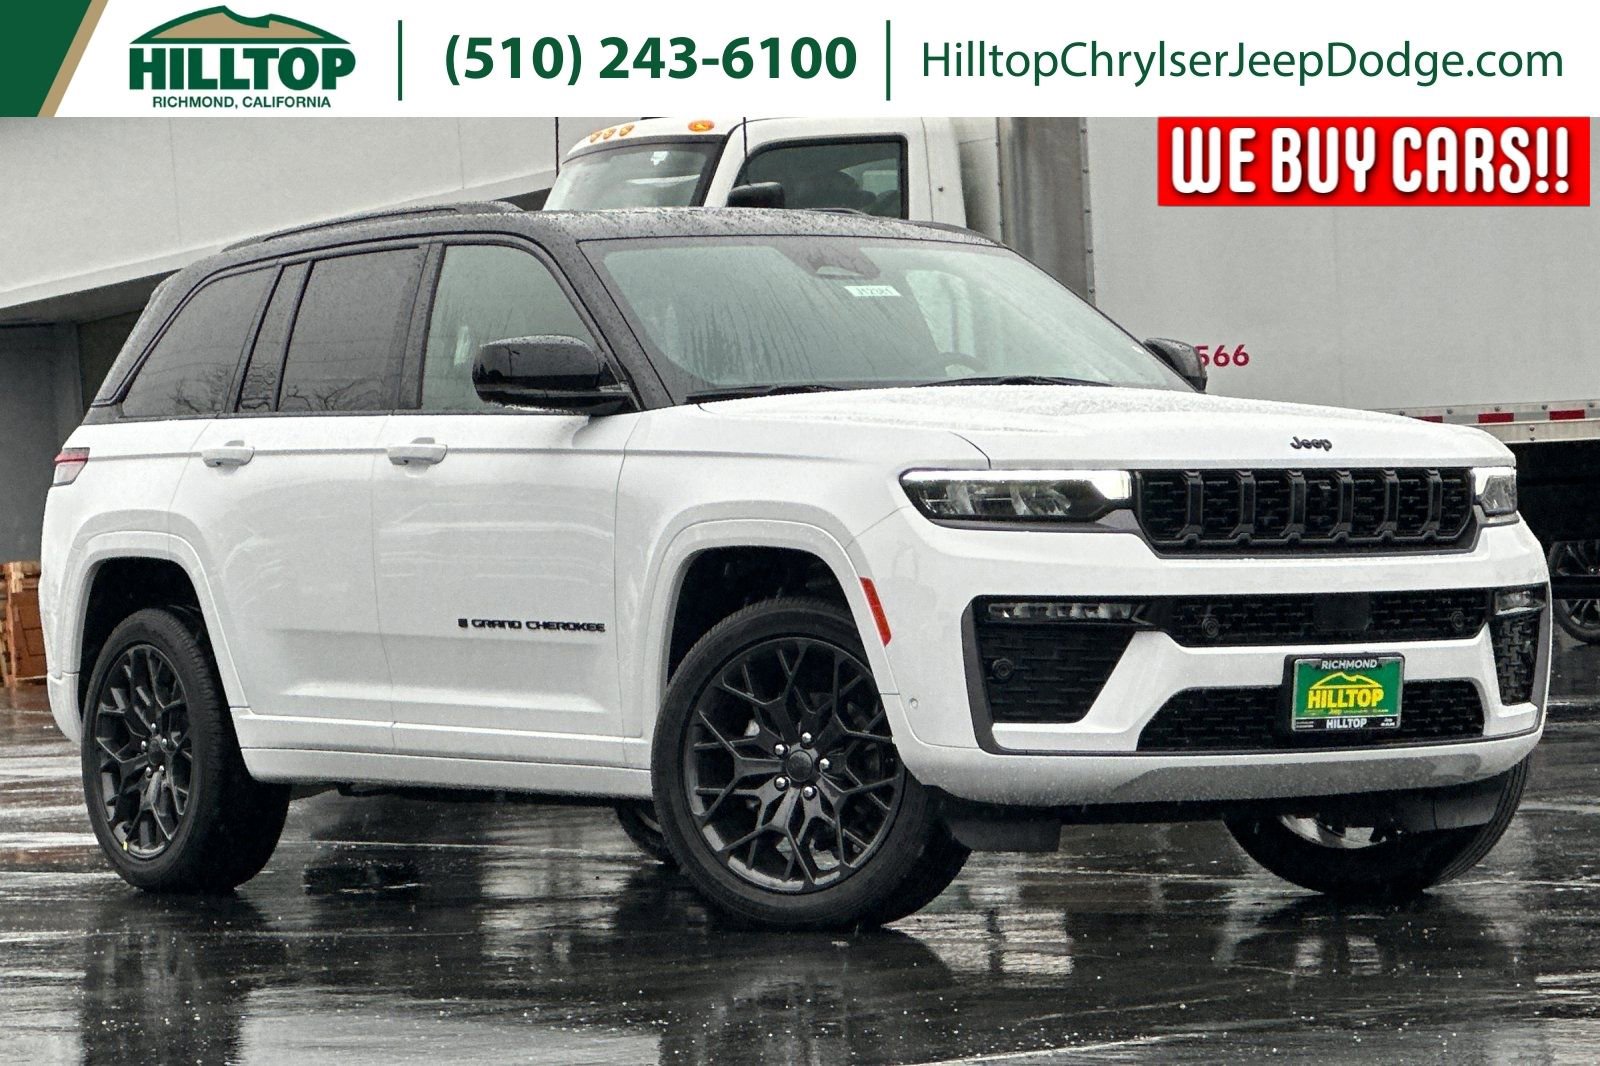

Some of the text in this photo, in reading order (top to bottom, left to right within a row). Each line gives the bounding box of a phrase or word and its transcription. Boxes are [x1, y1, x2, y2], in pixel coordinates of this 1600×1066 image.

[1290, 436, 1333, 452] Jeep
[471, 618, 606, 633] GRAND CHEROKEE
[1321, 659, 1378, 670] RICHMOND
[1307, 688, 1385, 709] HILLTOP
[1326, 718, 1368, 729] HILLTOP
